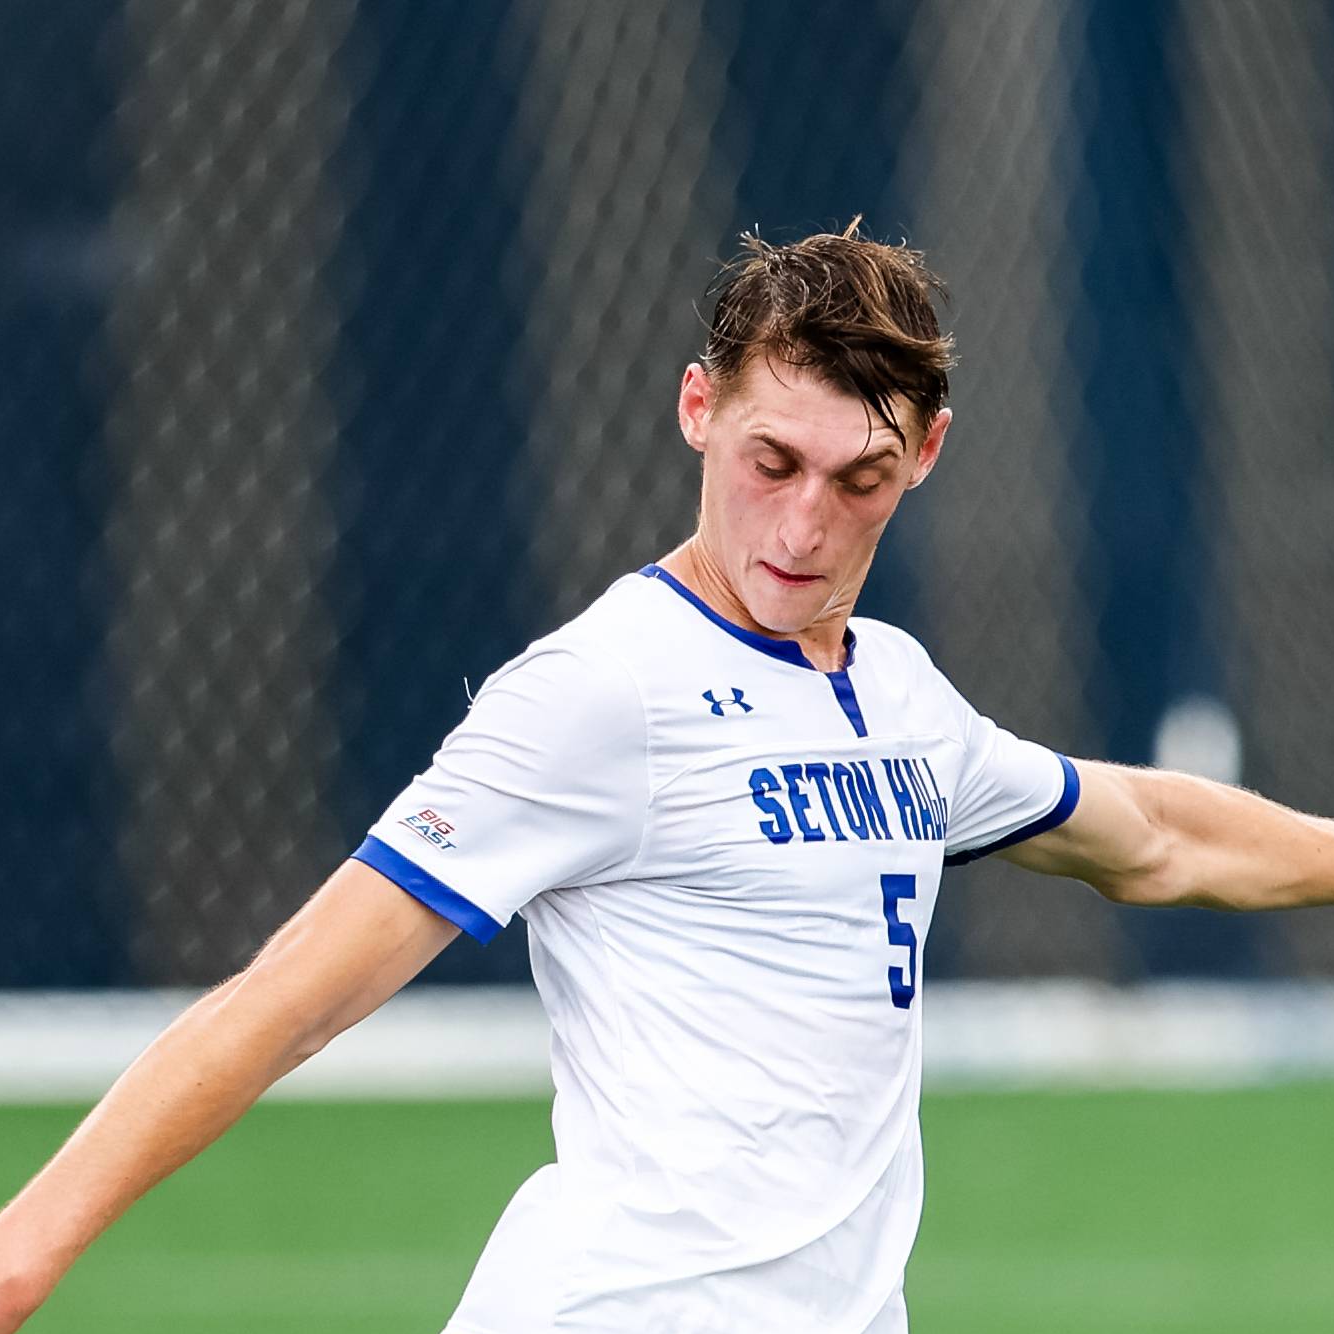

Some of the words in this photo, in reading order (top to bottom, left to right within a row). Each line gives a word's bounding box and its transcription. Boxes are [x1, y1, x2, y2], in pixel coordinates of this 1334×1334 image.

[419, 810, 455, 834] BIG
[748, 760, 893, 844] SETON
[880, 758, 947, 840] HALL
[405, 816, 457, 849] EAST
[880, 873, 917, 1009] 5
